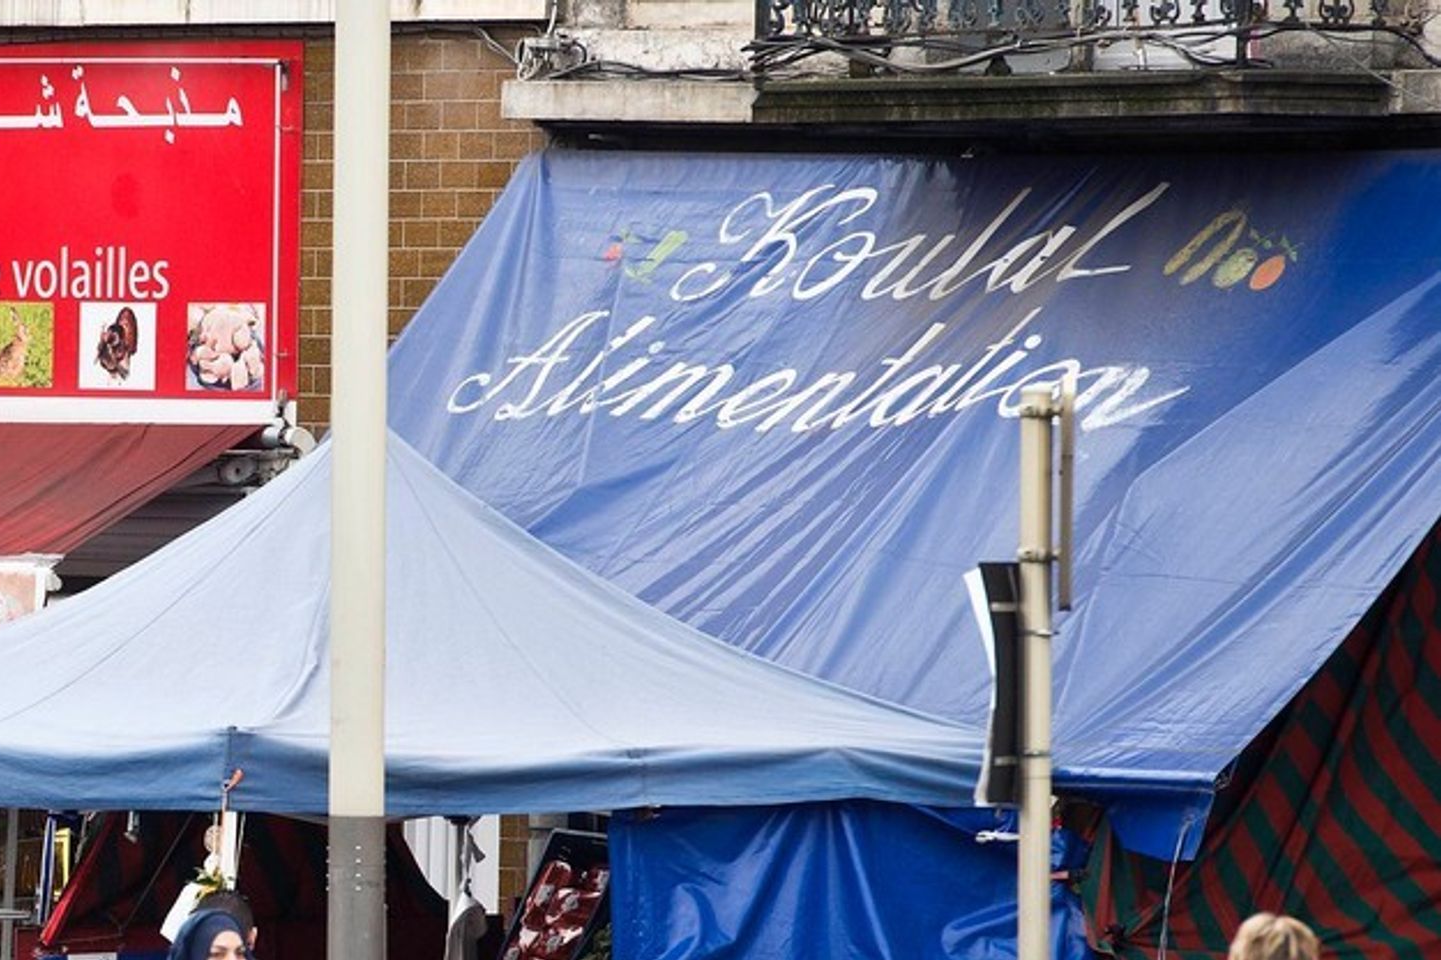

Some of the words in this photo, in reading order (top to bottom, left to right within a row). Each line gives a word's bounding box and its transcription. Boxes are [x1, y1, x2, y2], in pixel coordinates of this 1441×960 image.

[72, 65, 244, 144] مذبحة
[12, 246, 169, 299] volailles
[447, 308, 1191, 432] Alimentation
